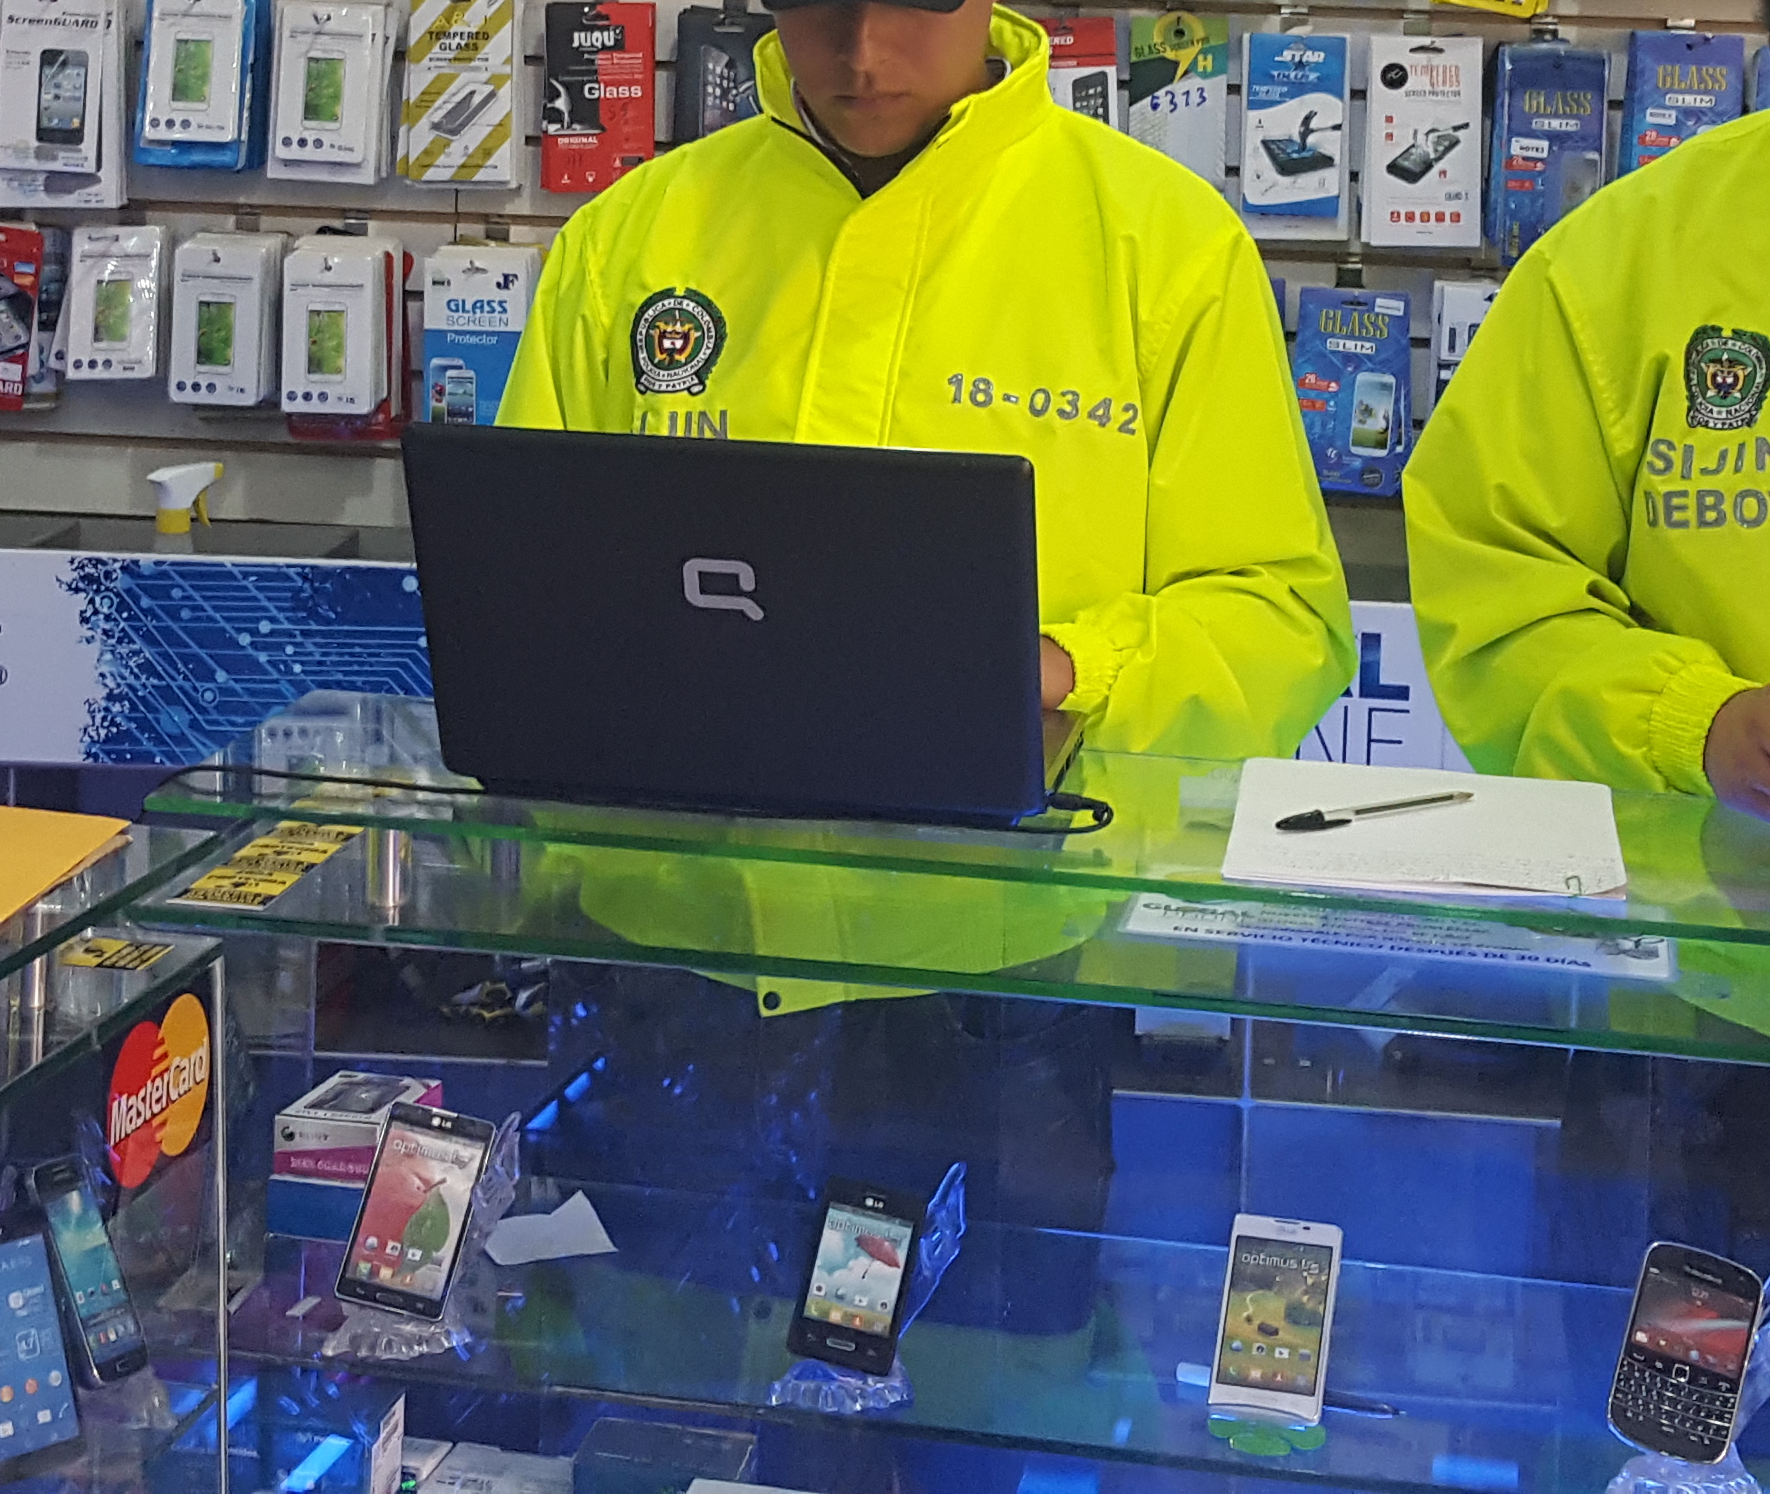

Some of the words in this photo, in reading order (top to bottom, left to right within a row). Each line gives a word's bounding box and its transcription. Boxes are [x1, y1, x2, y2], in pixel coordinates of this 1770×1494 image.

[428, 31, 490, 42] TEMPERED
[439, 42, 479, 52] GLASS
[1273, 49, 1326, 65] STAR
[1658, 64, 1727, 92] GLASS
[583, 83, 643, 100] Glass
[1524, 89, 1591, 116] GLASS
[495, 273, 518, 292] JF
[446, 297, 510, 316] GLASS
[445, 315, 509, 328] SCREEN
[1319, 309, 1389, 340] GLASS
[446, 332, 499, 347] Protector
[946, 371, 1143, 437] 18-0342
[109, 1035, 209, 1148] MasterCard
[1241, 1253, 1298, 1270] optimus
